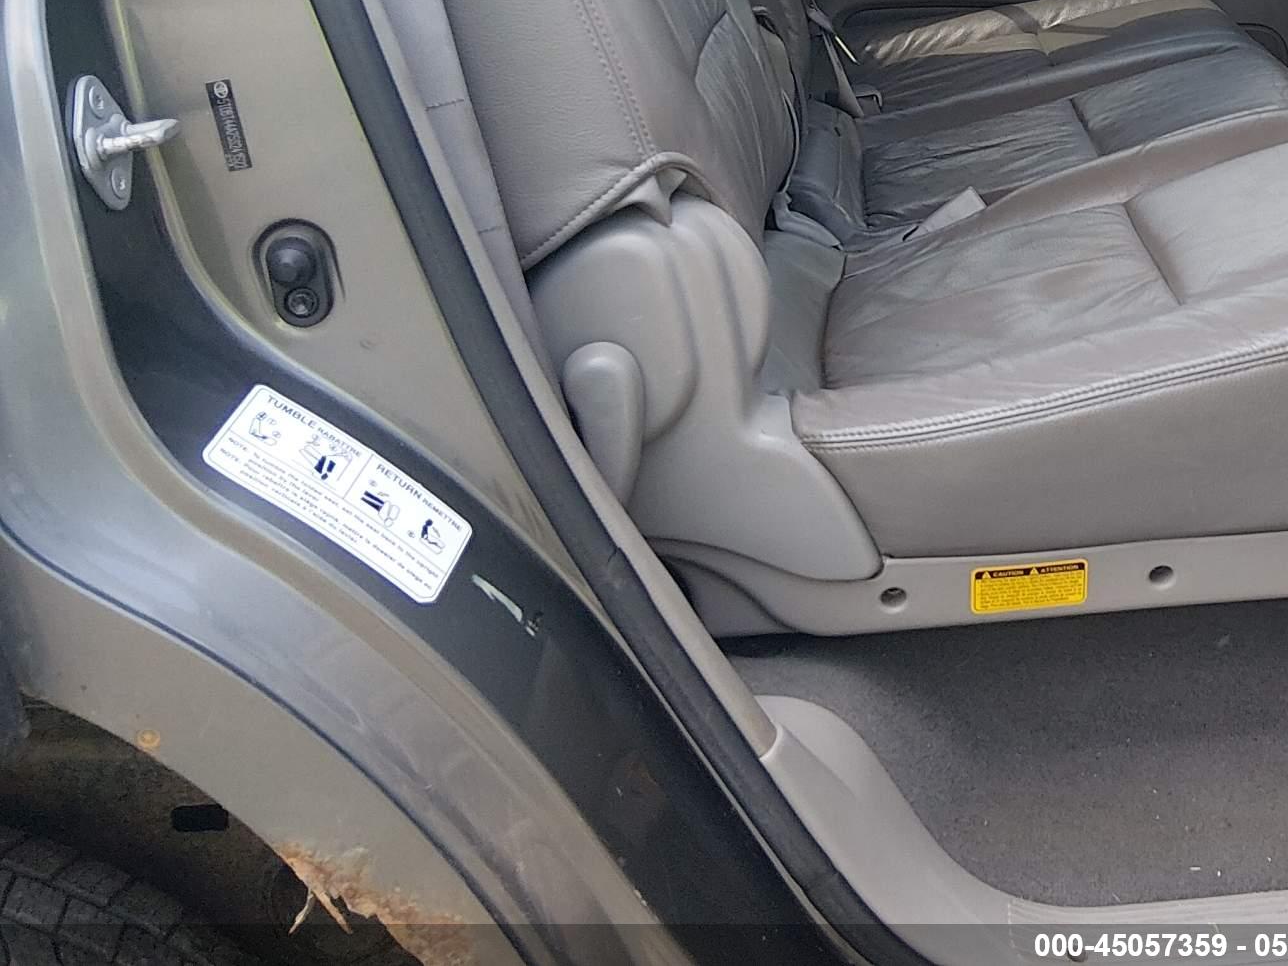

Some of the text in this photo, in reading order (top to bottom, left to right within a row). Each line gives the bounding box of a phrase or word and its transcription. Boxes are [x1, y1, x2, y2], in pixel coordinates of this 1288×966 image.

[267, 394, 317, 429] TUMBLE
[376, 463, 423, 499] RETURN
[992, 564, 1079, 578] CAUTION ATTENTION
